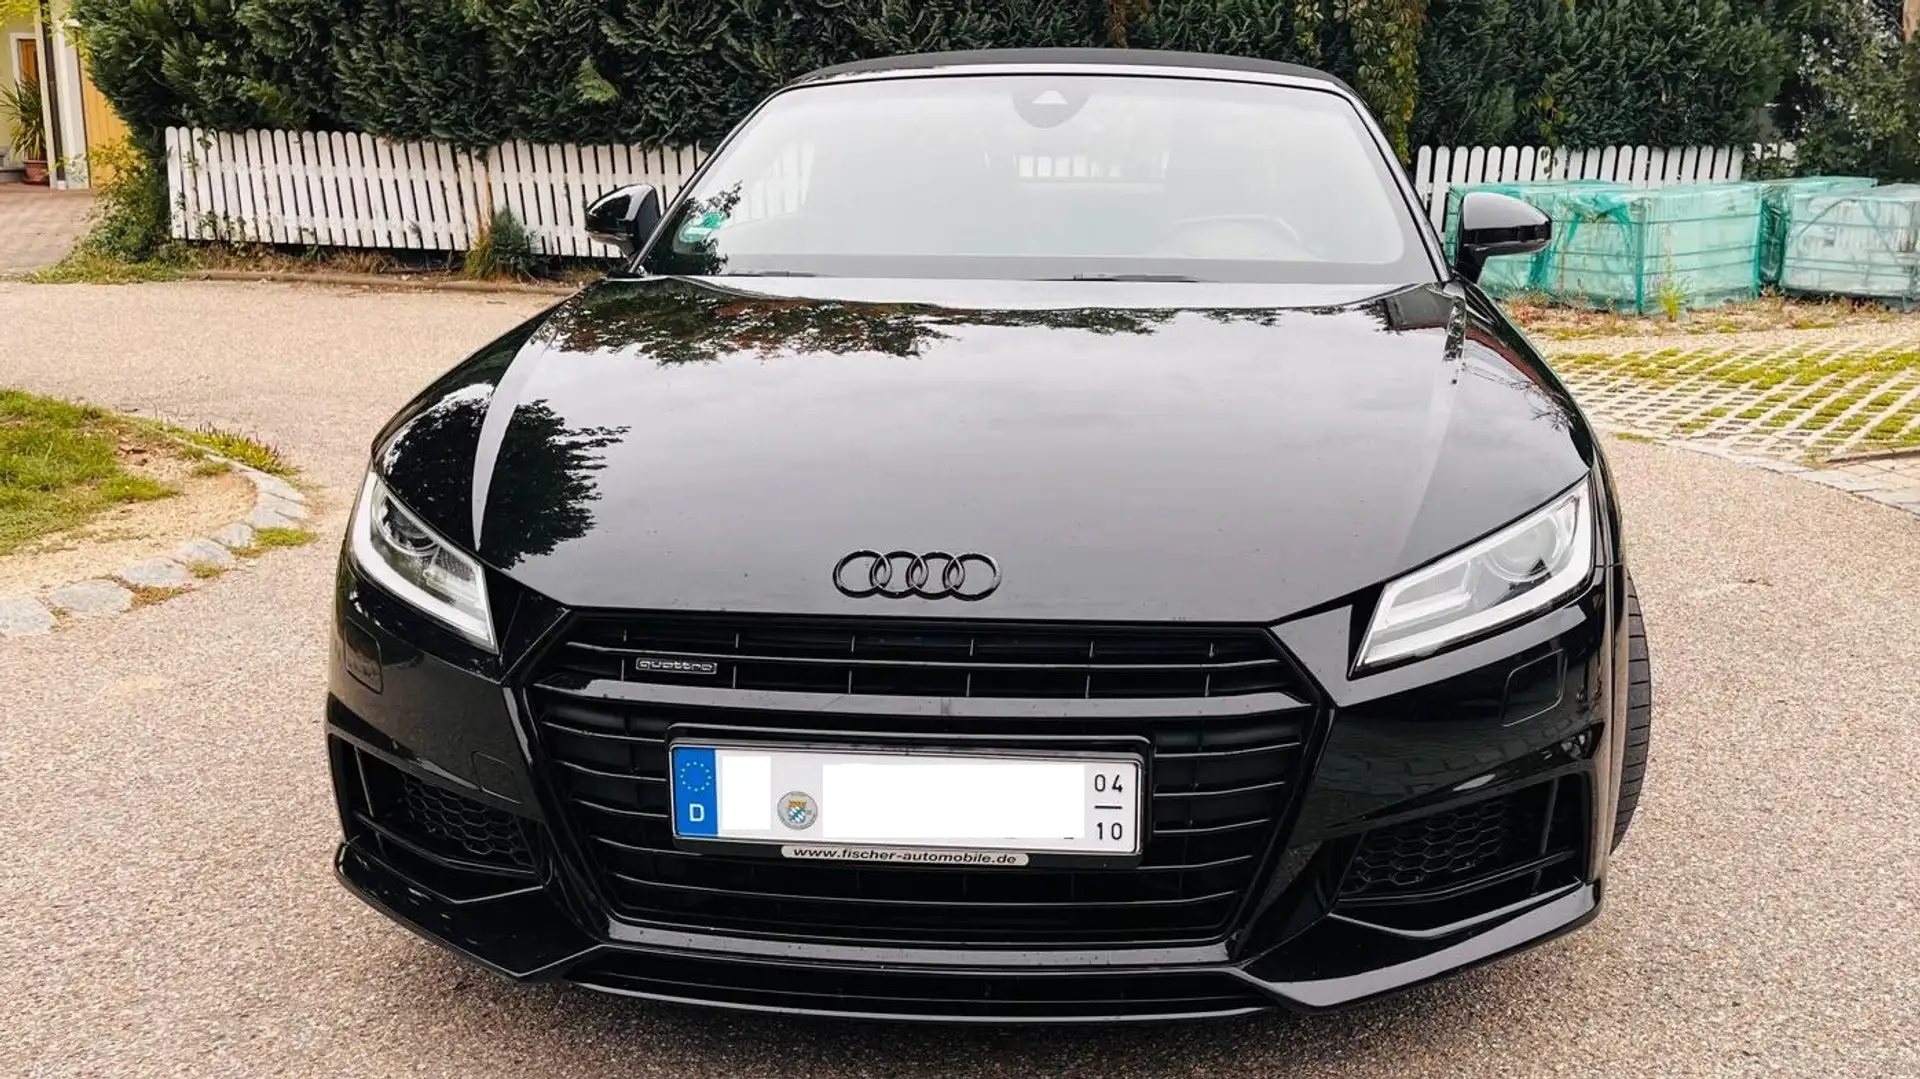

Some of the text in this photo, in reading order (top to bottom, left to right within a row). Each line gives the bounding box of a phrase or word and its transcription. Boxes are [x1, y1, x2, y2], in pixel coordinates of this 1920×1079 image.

[639, 660, 714, 671] quattro
[1094, 774, 1123, 792] 04
[689, 803, 705, 822] D
[1096, 822, 1123, 840] 10
[793, 848, 1017, 864] www.fischer-automobile.de
